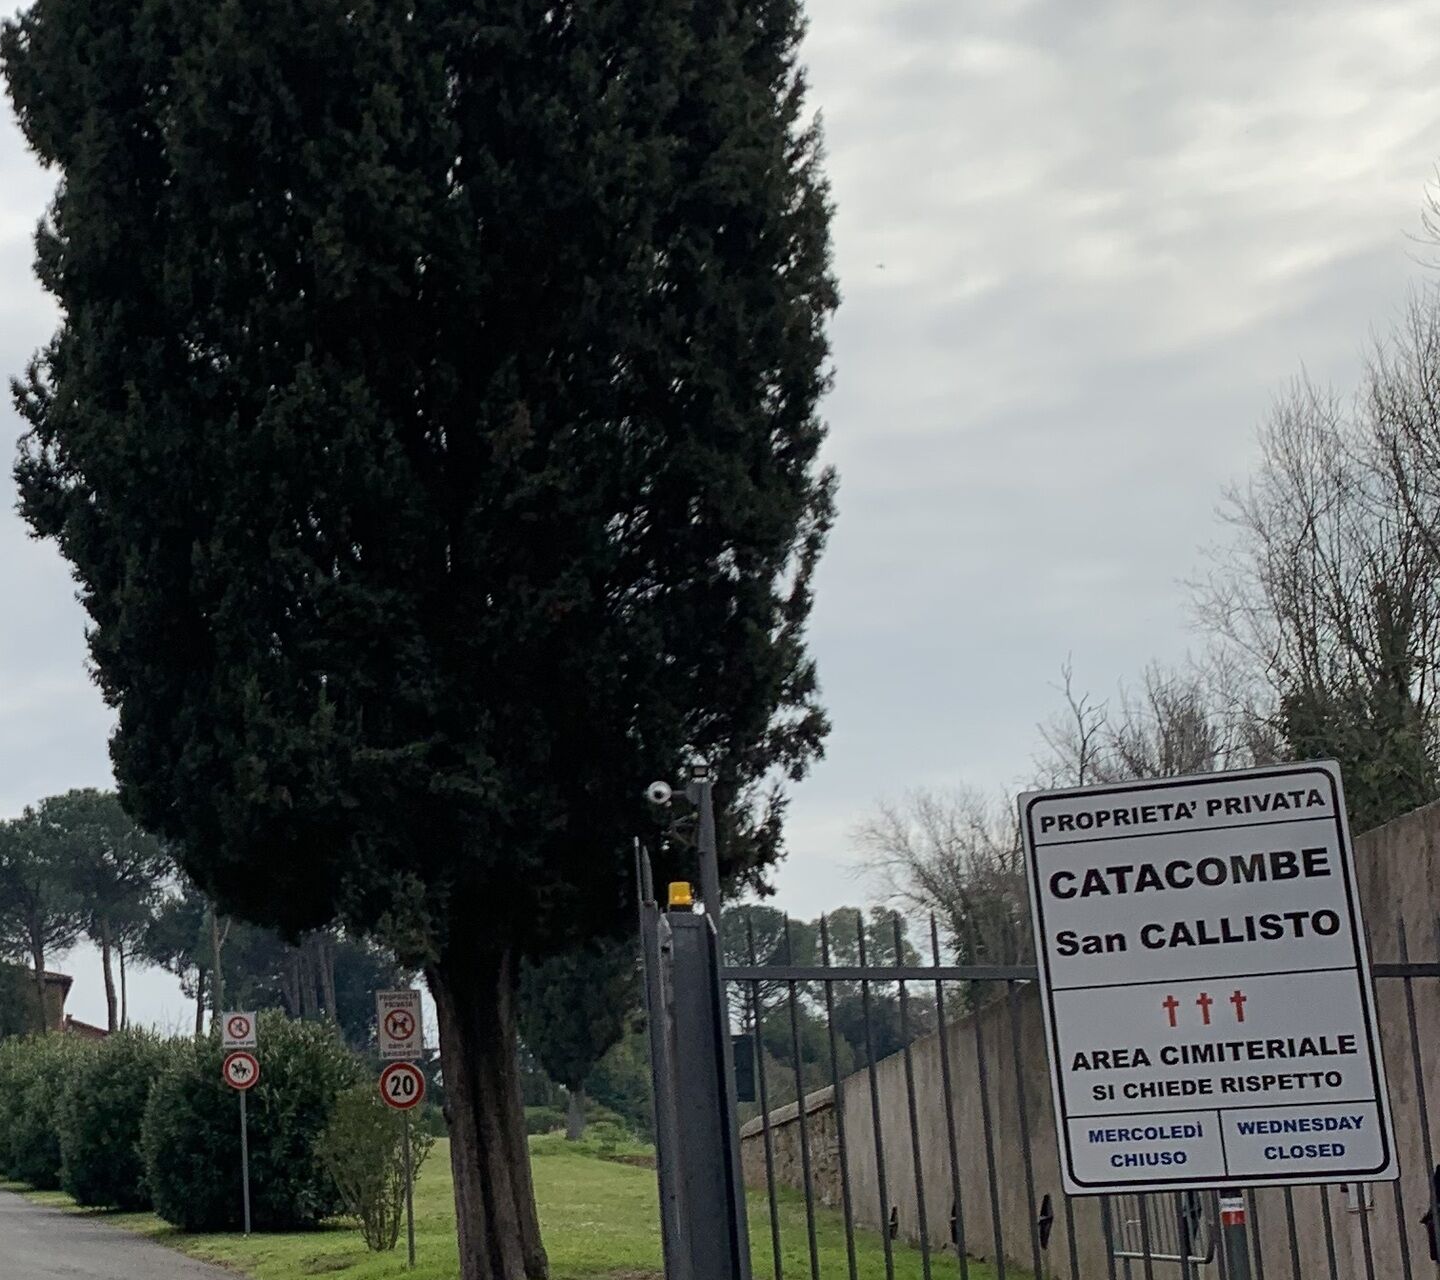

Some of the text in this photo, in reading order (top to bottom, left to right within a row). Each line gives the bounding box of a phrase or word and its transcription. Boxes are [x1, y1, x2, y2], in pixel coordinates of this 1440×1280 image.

[1040, 788, 1326, 834] PROPRIETA' PRIVATA
[1049, 847, 1332, 900] CATACOMBE
[1055, 909, 1341, 957] San CALLISTO
[1071, 1034, 1358, 1072] AREA CIMITERIALE
[390, 1075, 415, 1097] 20
[1092, 1070, 1343, 1101] SI CHIEDE RISPETTO
[1088, 1115, 1364, 1143] MERCOLEDÌ WEDNESDAY
[1110, 1143, 1346, 1168] CHIUSO CLOSED
